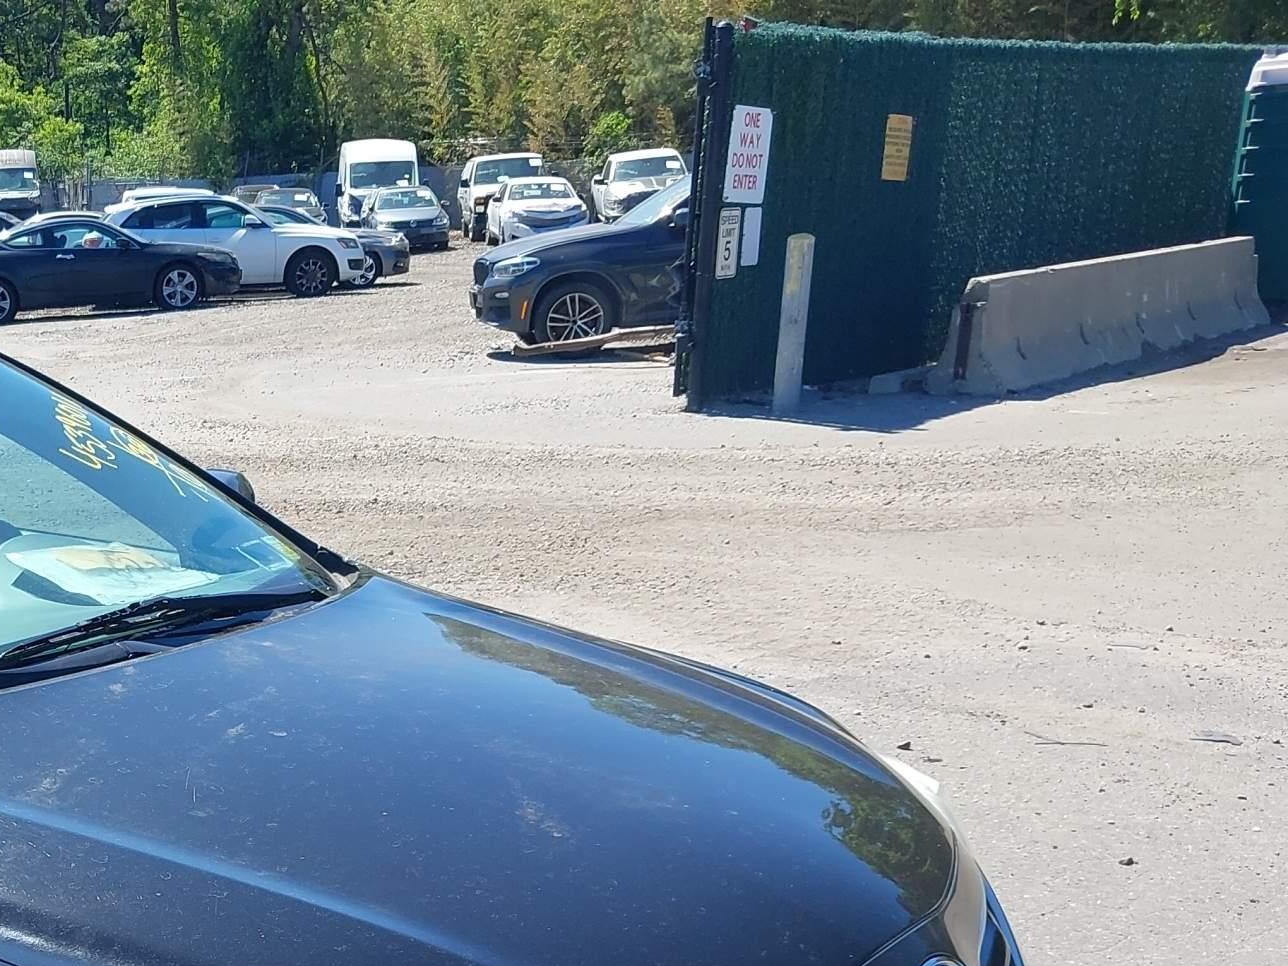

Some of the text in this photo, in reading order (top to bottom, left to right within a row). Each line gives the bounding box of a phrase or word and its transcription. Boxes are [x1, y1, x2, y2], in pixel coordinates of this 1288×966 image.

[744, 111, 762, 129] ONE
[739, 132, 762, 149] WAY
[731, 152, 764, 169] DO NOT
[732, 173, 758, 190] ENTER
[721, 215, 739, 225] SPEED
[721, 228, 737, 239] LIMIT
[723, 240, 732, 262] 5
